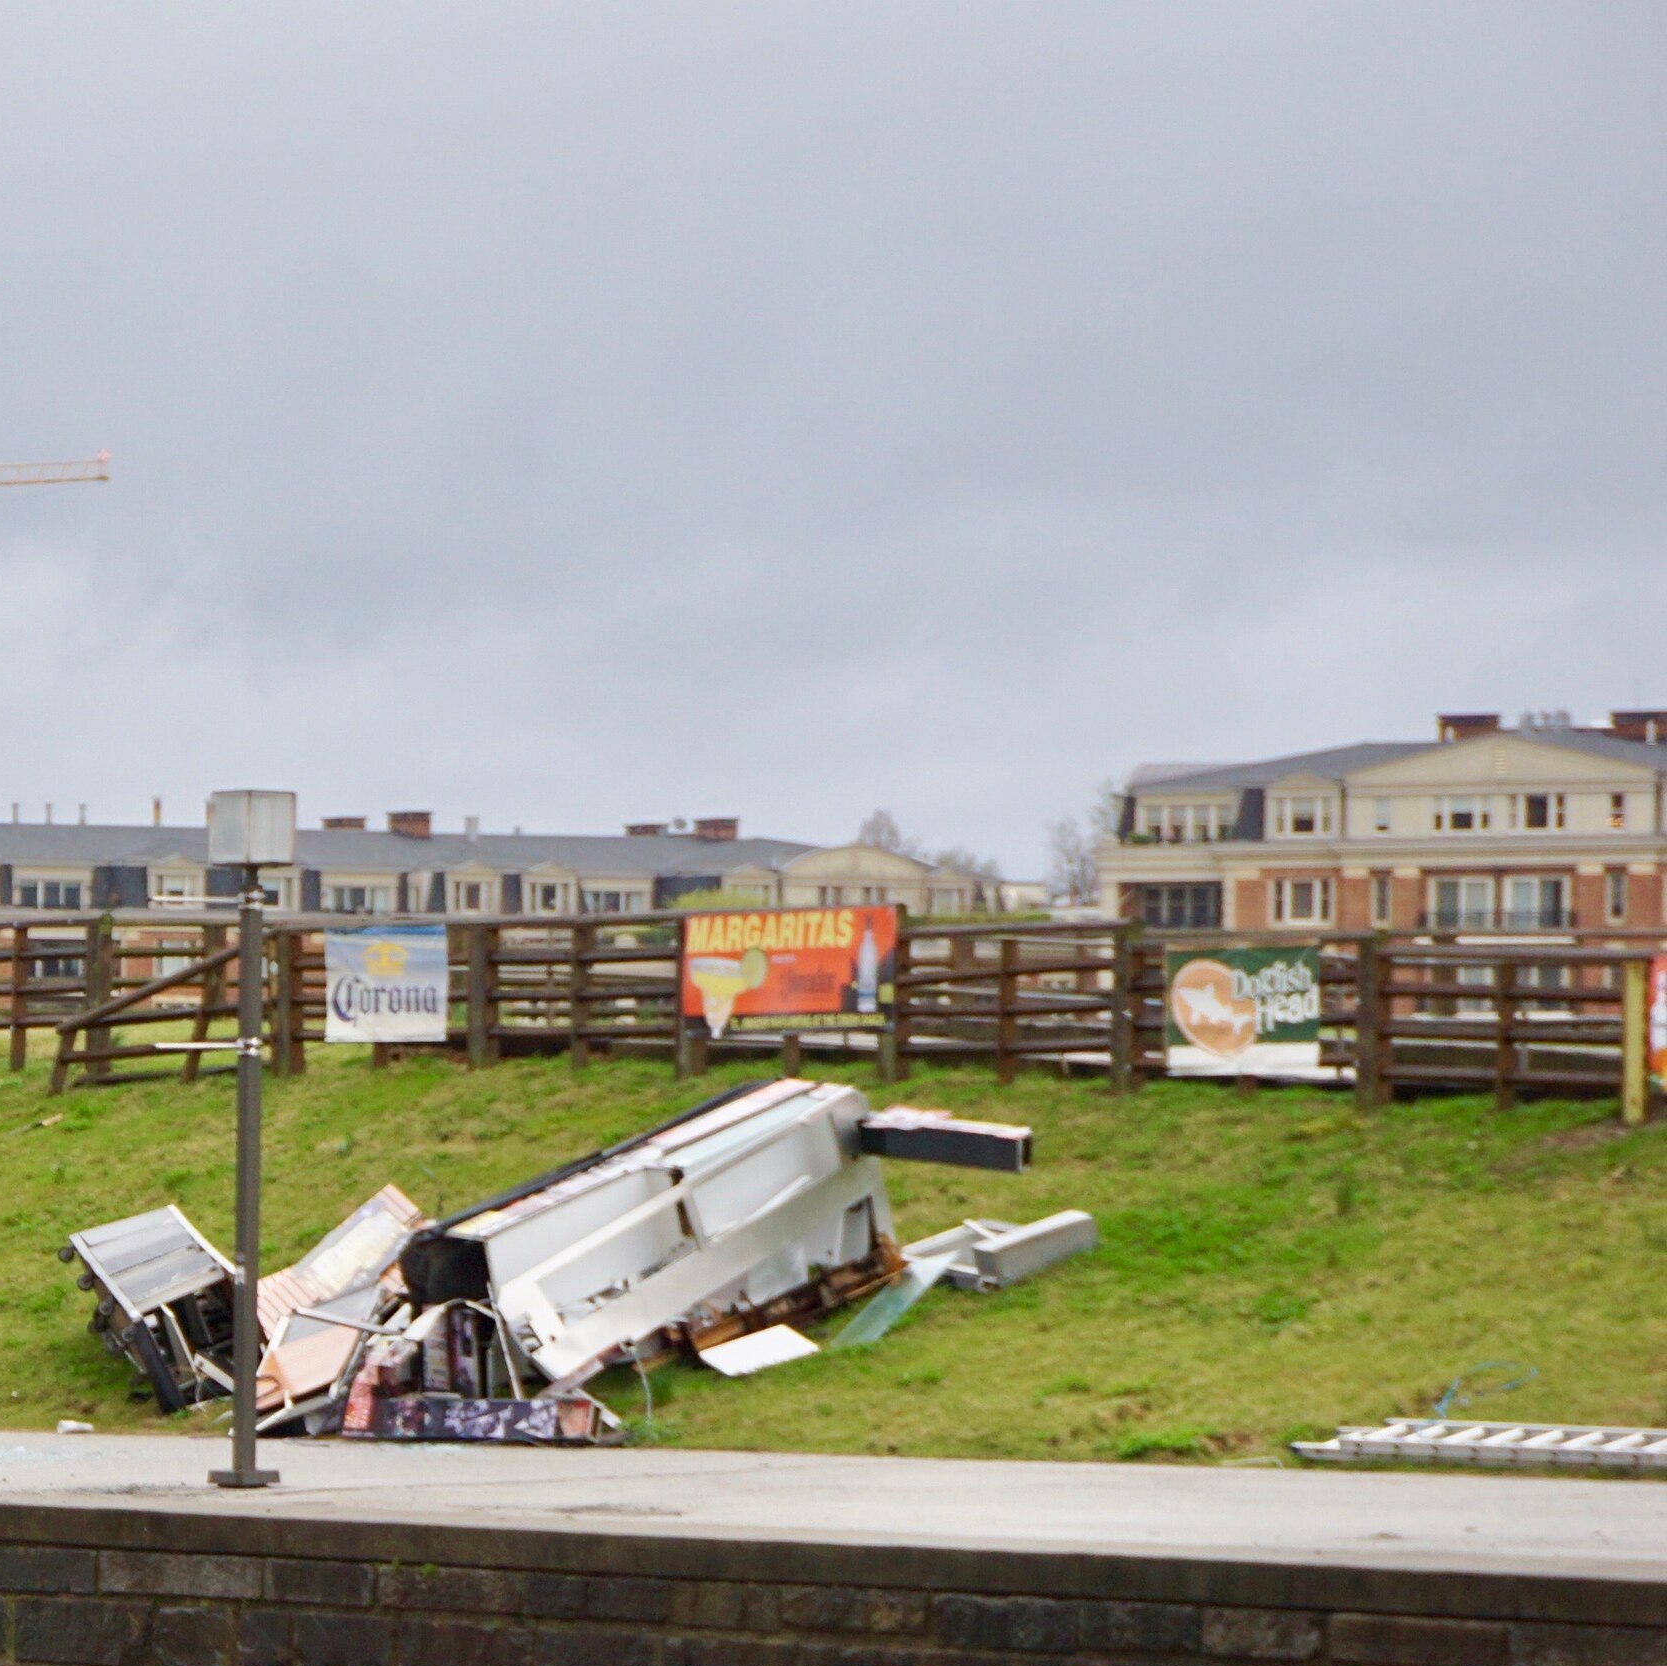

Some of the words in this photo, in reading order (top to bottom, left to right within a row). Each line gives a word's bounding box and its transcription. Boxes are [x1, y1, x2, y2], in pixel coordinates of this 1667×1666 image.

[686, 909, 854, 953] MARGARITAS
[332, 975, 439, 1027] Corona
[1232, 960, 1312, 1000] Dogfish
[1254, 983, 1320, 1034] Head
